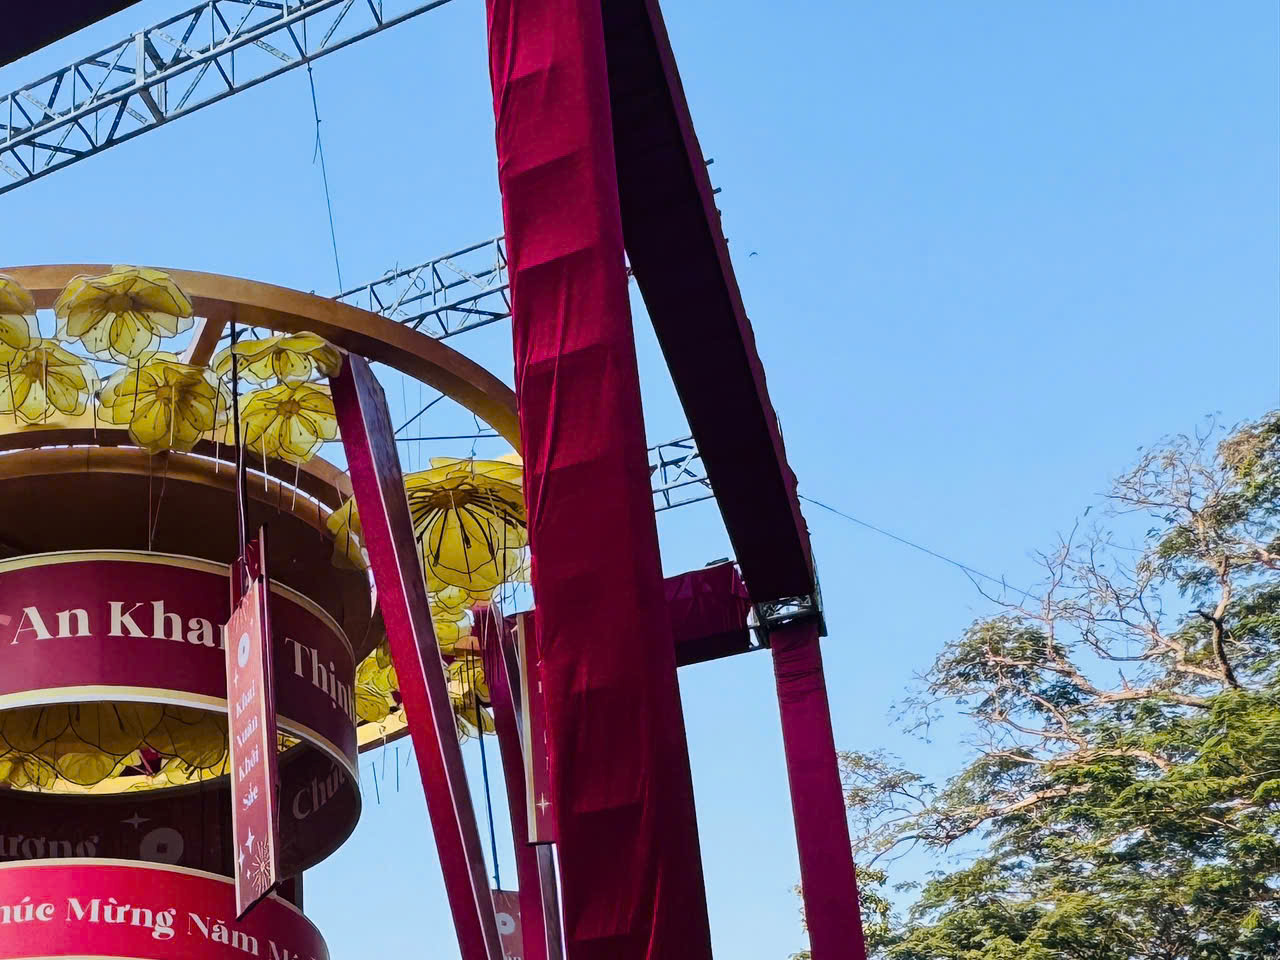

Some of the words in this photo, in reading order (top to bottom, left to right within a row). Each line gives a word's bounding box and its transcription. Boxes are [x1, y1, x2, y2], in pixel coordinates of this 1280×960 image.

[10, 606, 92, 645] An
[107, 600, 225, 649] Kha
[66, 897, 176, 940] Mừng
[188, 912, 259, 956] Năm
